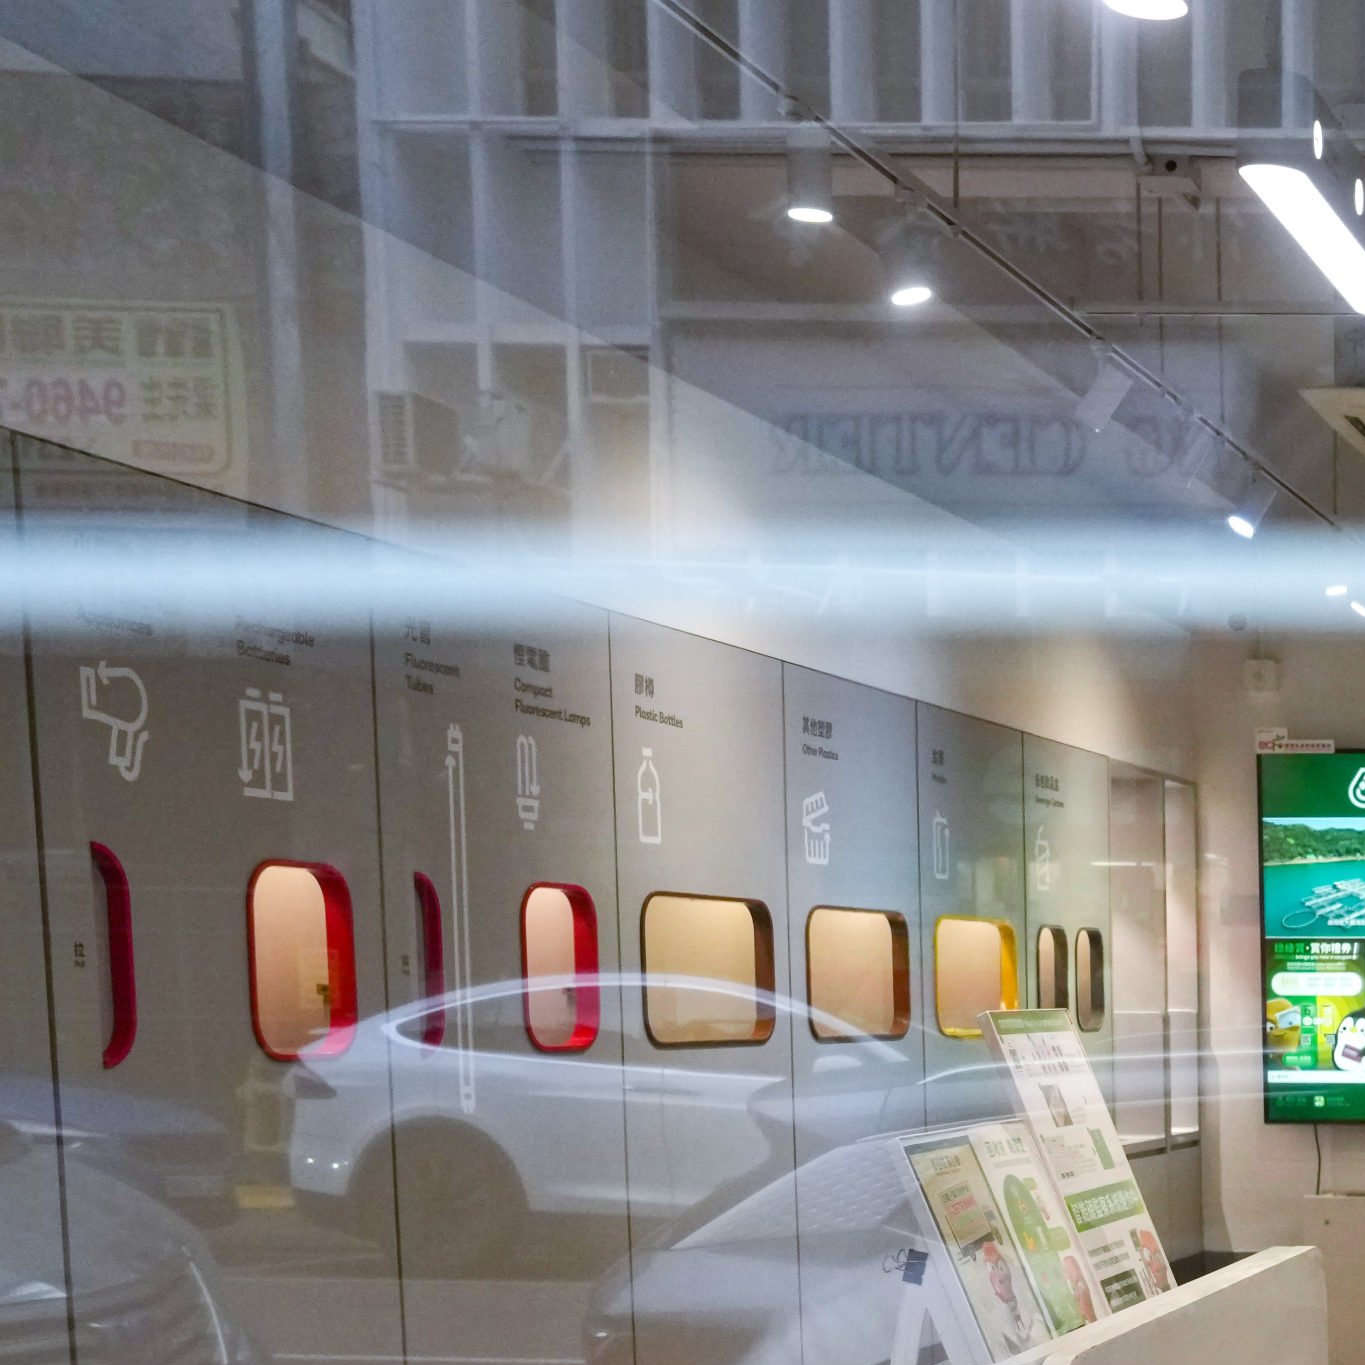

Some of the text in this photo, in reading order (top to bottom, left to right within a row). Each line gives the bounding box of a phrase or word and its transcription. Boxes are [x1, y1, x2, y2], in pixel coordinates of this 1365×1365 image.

[514, 677, 553, 699] Compact
[515, 699, 591, 728] Fluorescent Lamps
[634, 704, 684, 729] Plastic Bottles
